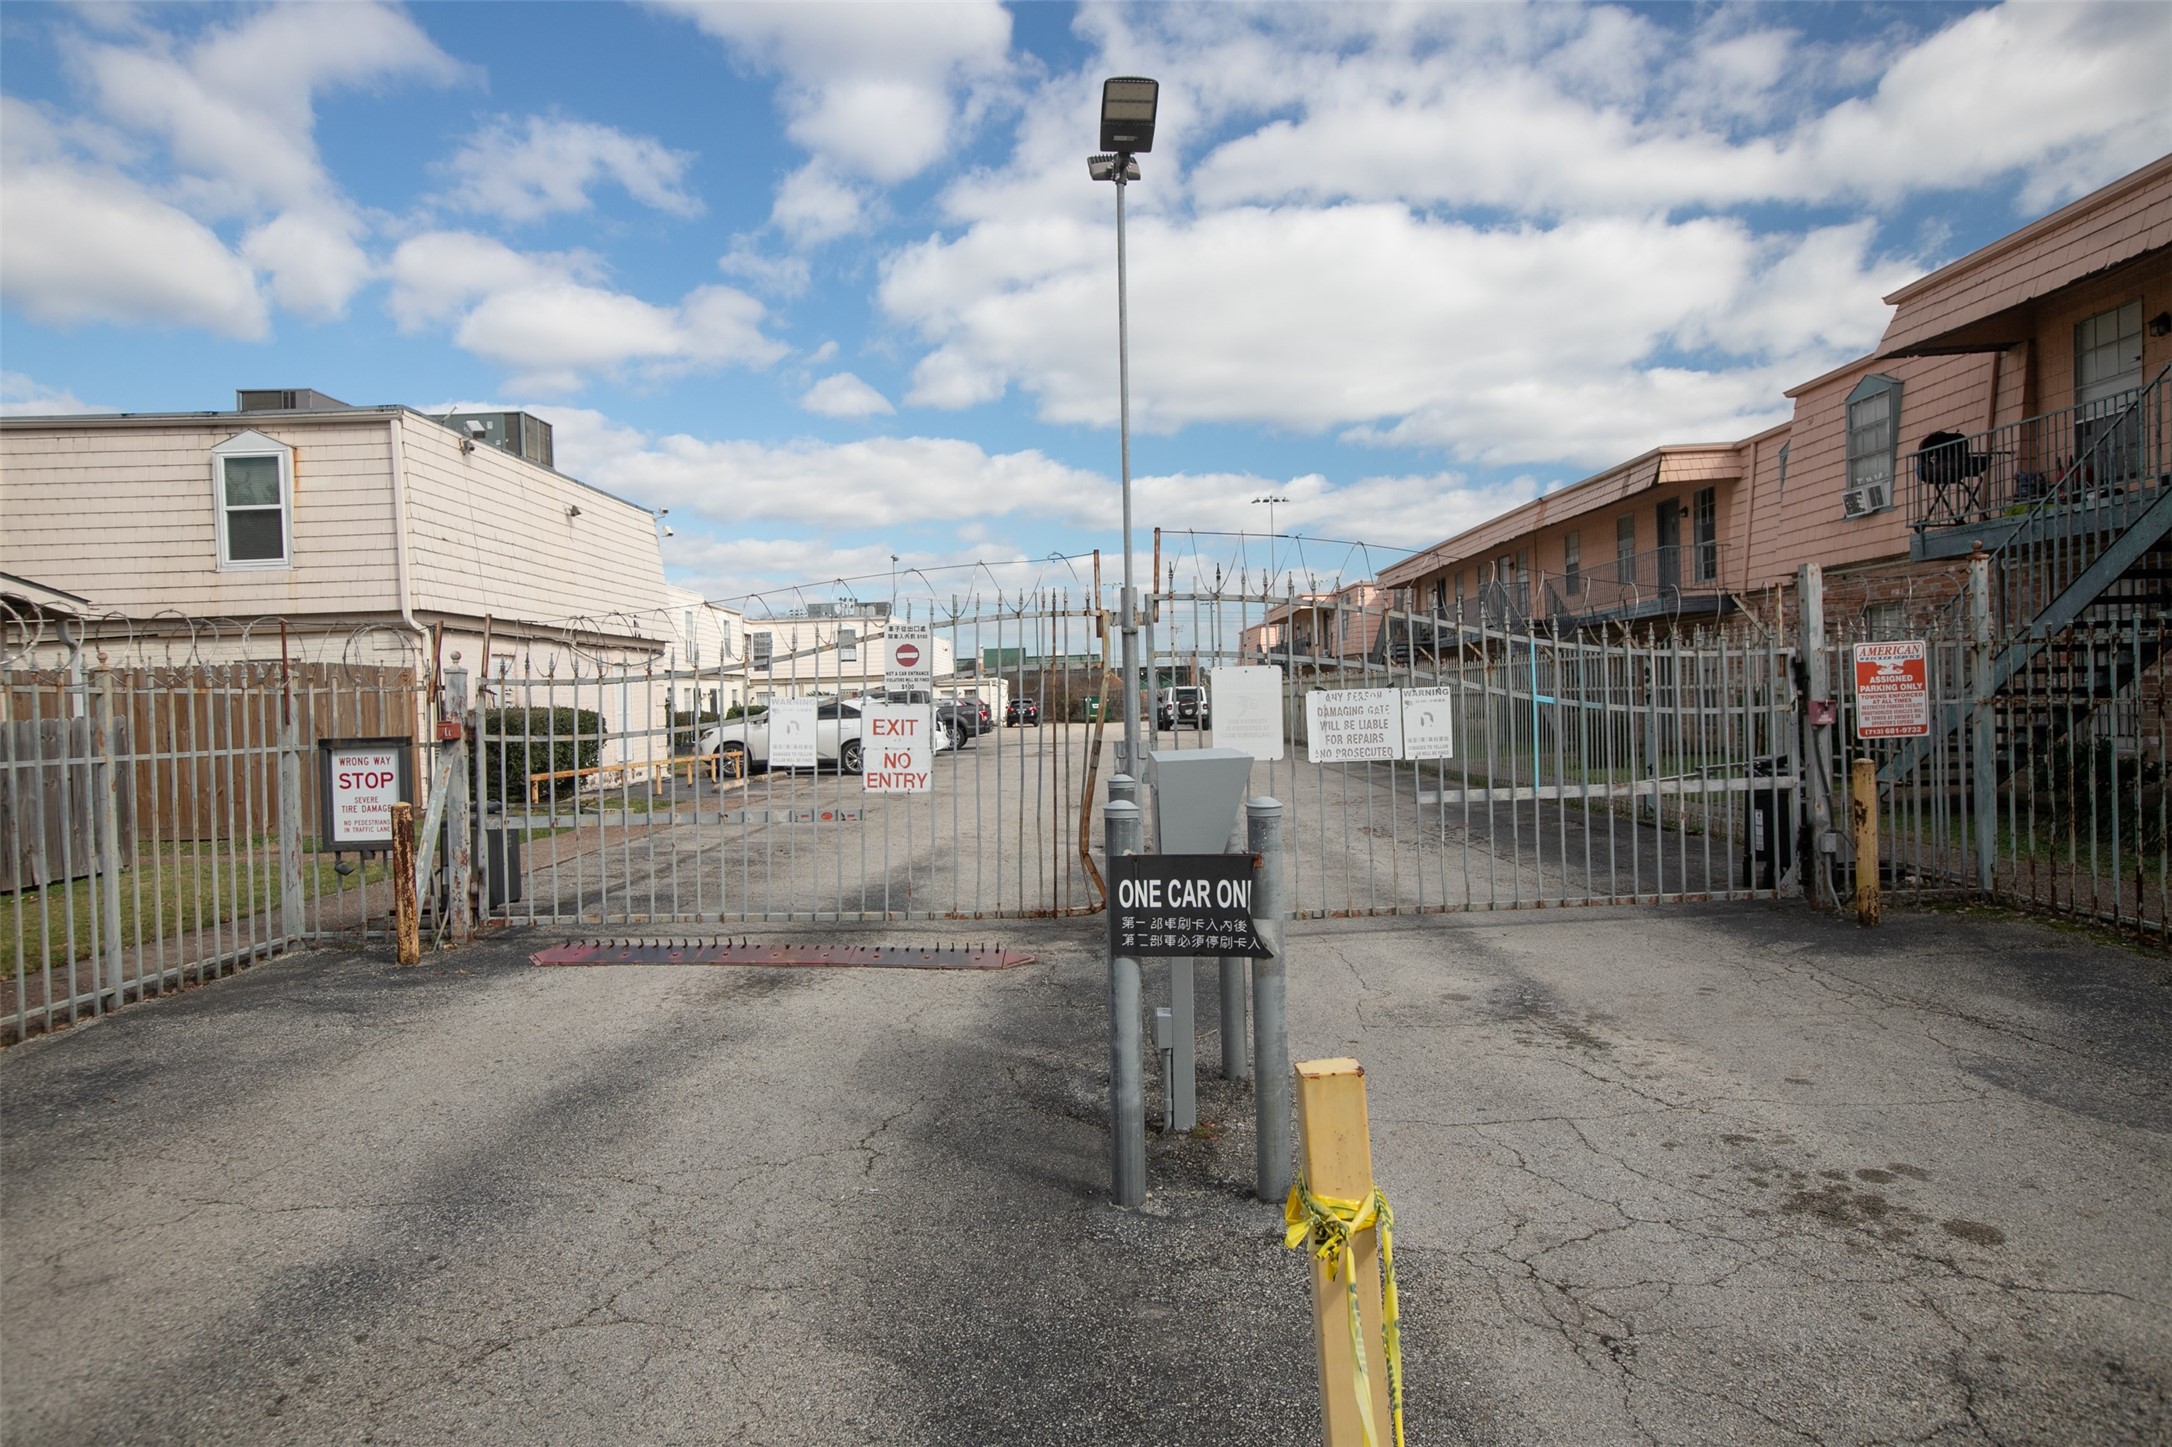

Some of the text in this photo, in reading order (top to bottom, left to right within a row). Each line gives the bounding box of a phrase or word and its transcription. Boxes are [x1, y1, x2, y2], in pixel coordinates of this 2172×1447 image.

[1859, 645, 1920, 656] AMERICAN
[1870, 675, 1913, 683] ASSIGNED
[1403, 688, 1449, 697] WARNING
[1860, 684, 1897, 692] PARKING
[1326, 693, 1343, 702] ANY
[1317, 705, 1390, 717] DAMAGING GATE
[872, 719, 918, 736] EXIT
[1320, 719, 1388, 732] WILL BE LIABLE
[1325, 733, 1384, 745] FOR REPAIRS
[1336, 747, 1393, 758] PROSECUTED
[339, 756, 391, 766] WRONG WAY
[884, 752, 911, 769] NO
[338, 772, 394, 789] STOP
[867, 772, 928, 788] ENTRY
[354, 796, 379, 804] SEVERE
[341, 804, 392, 813] TIRE DAMAGE
[1119, 879, 1162, 908] ONE
[1168, 879, 1212, 908] CAR
